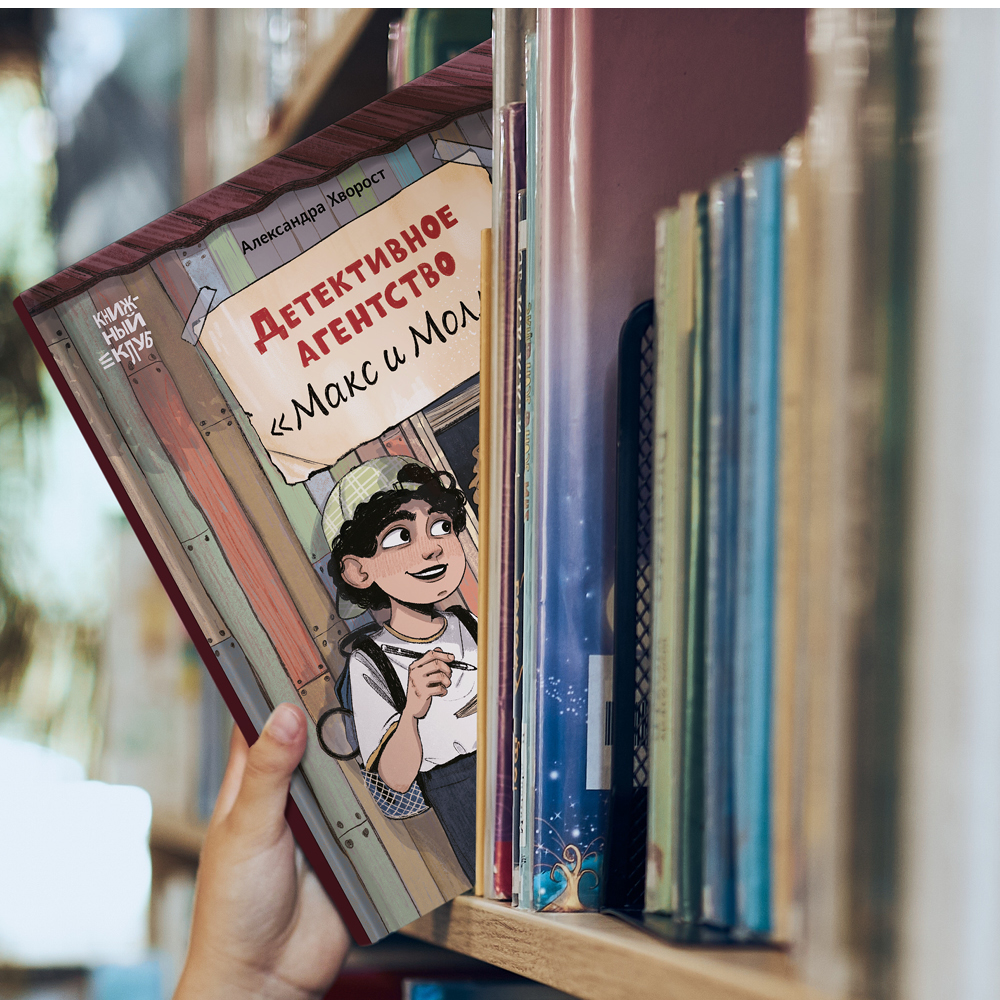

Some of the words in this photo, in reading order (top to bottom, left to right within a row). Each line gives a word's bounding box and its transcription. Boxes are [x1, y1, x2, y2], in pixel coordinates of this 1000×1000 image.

[241, 202, 326, 255] Александра
[326, 169, 386, 208] Хворост
[297, 251, 456, 368] АГЕНТСТВО
[383, 346, 406, 372] и
[409, 290, 481, 358] Мол
